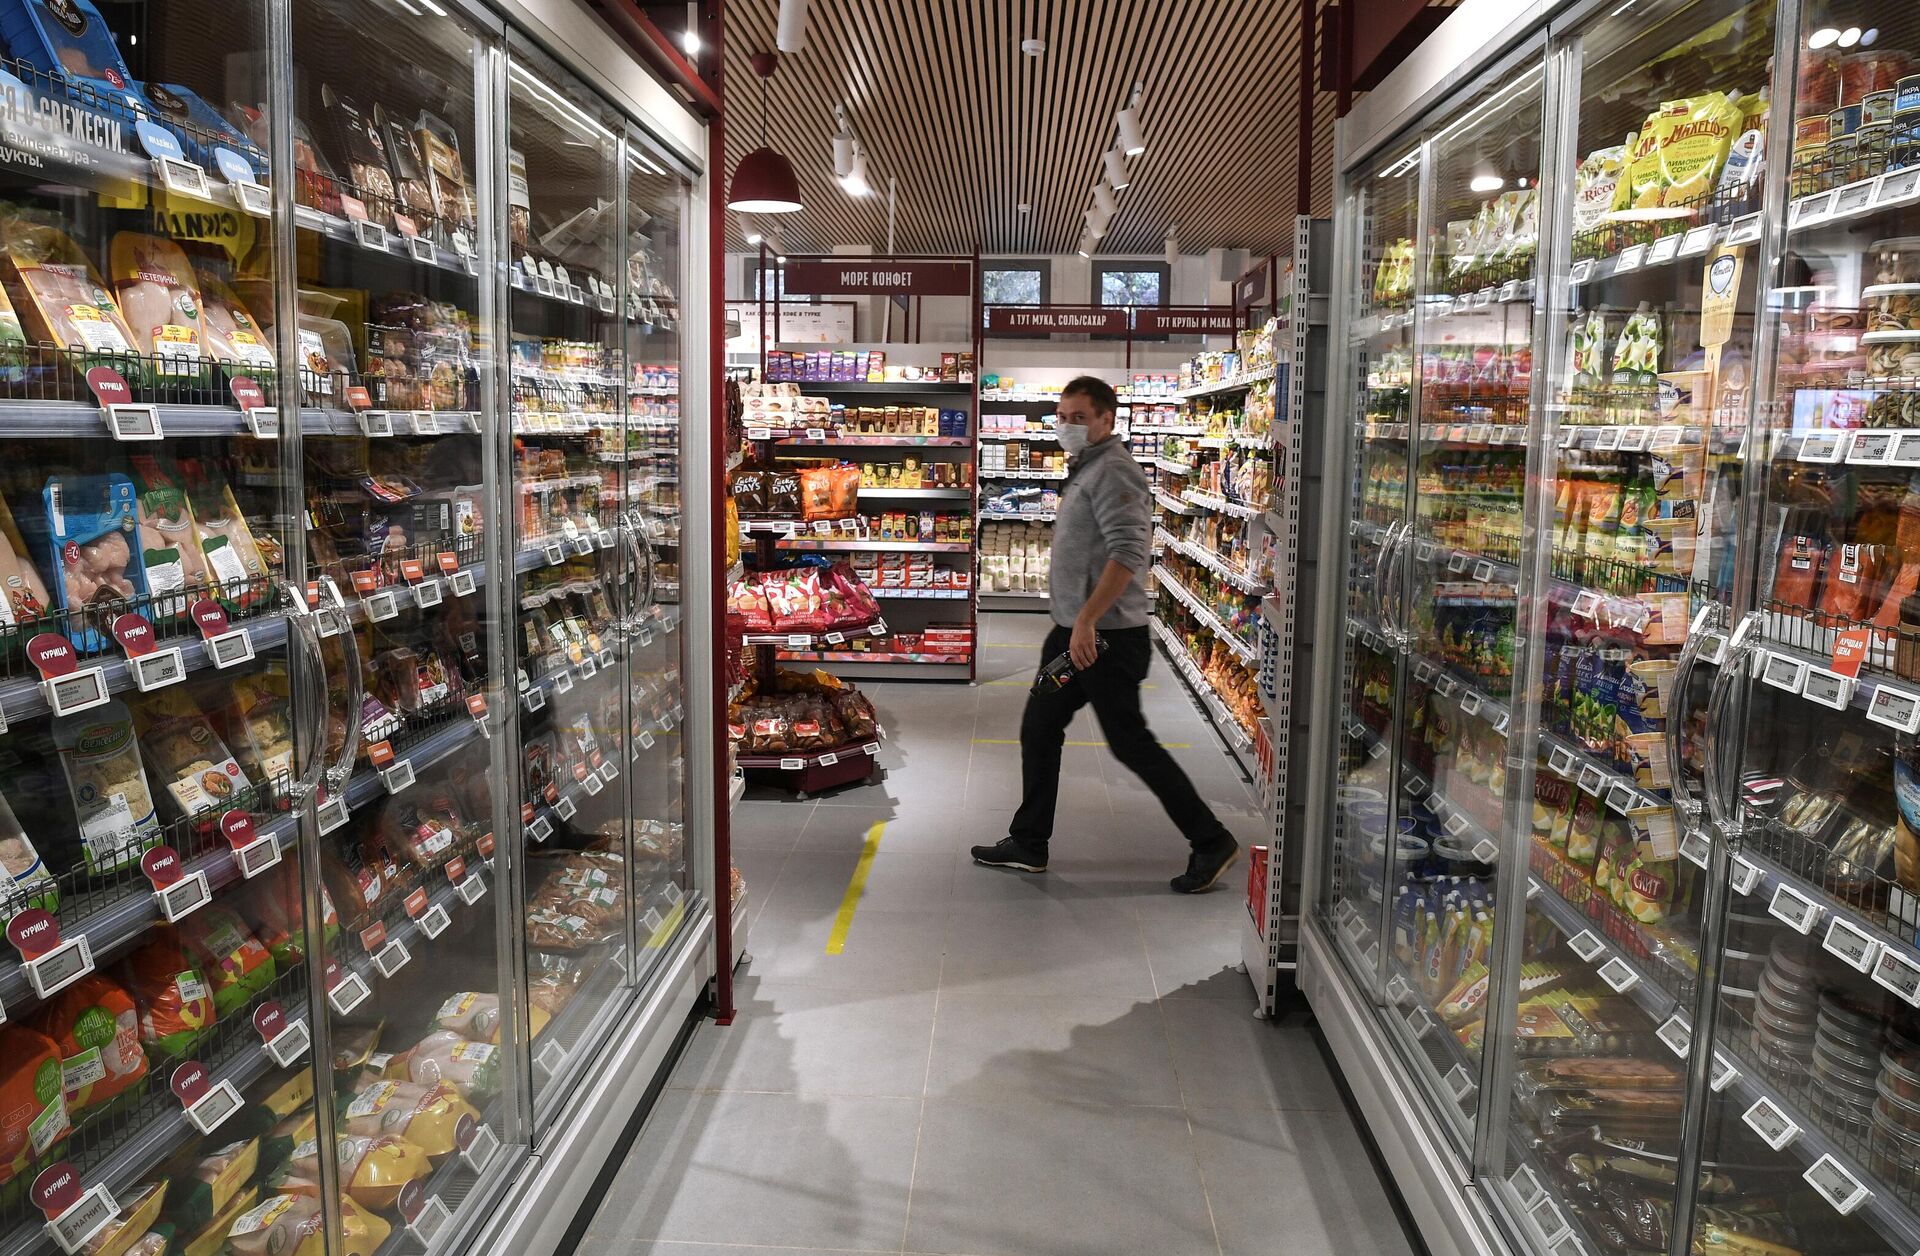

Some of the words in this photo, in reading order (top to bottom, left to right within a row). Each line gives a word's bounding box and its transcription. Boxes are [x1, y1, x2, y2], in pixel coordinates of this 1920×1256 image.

[1902, 86, 1920, 96] ИКРА
[40, 96, 127, 156] СВЕЖЕСТИ.
[1666, 154, 1715, 168] ЛИМОННЫМ
[1671, 164, 1700, 174] СОКОМ
[1584, 182, 1616, 202] Ricco
[841, 271, 869, 286] МОРЕ
[872, 271, 913, 286] КОНФЕТ
[1010, 314, 1015, 325] А
[1017, 314, 1030, 326] ТУТ
[1032, 314, 1056, 327] МУКА,
[1058, 314, 1107, 326] СОЛЬ/САХАР
[1157, 316, 1170, 328] ТУТ
[1172, 316, 1199, 328] КРУПЫ
[1201, 316, 1207, 328] И
[99, 381, 123, 392] КУРИЦА
[239, 388, 259, 397] КУРИЦА
[735, 482, 760, 494] DAYS
[736, 475, 758, 489] Lucky
[772, 484, 797, 495] DAYS
[201, 611, 221, 622] КУРИЦА
[124, 625, 148, 640] КУРИЦА
[1839, 637, 1864, 650] ЛУЧШАЯ
[40, 646, 68, 660] КУРИЦА
[1836, 646, 1851, 657] ЦЕНА
[229, 818, 248, 833] КУРИЦА
[151, 855, 174, 872] КУРИЦА
[20, 919, 50, 940] КУРИЦА
[81, 1012, 108, 1033] НАША
[262, 1009, 279, 1027] КУРИЦА
[81, 1025, 113, 1046] ПТИЧКА
[181, 1070, 201, 1090] КУРИЦА
[43, 1172, 71, 1199] КУРИЦА
[73, 1202, 102, 1231] МАГНИТ
